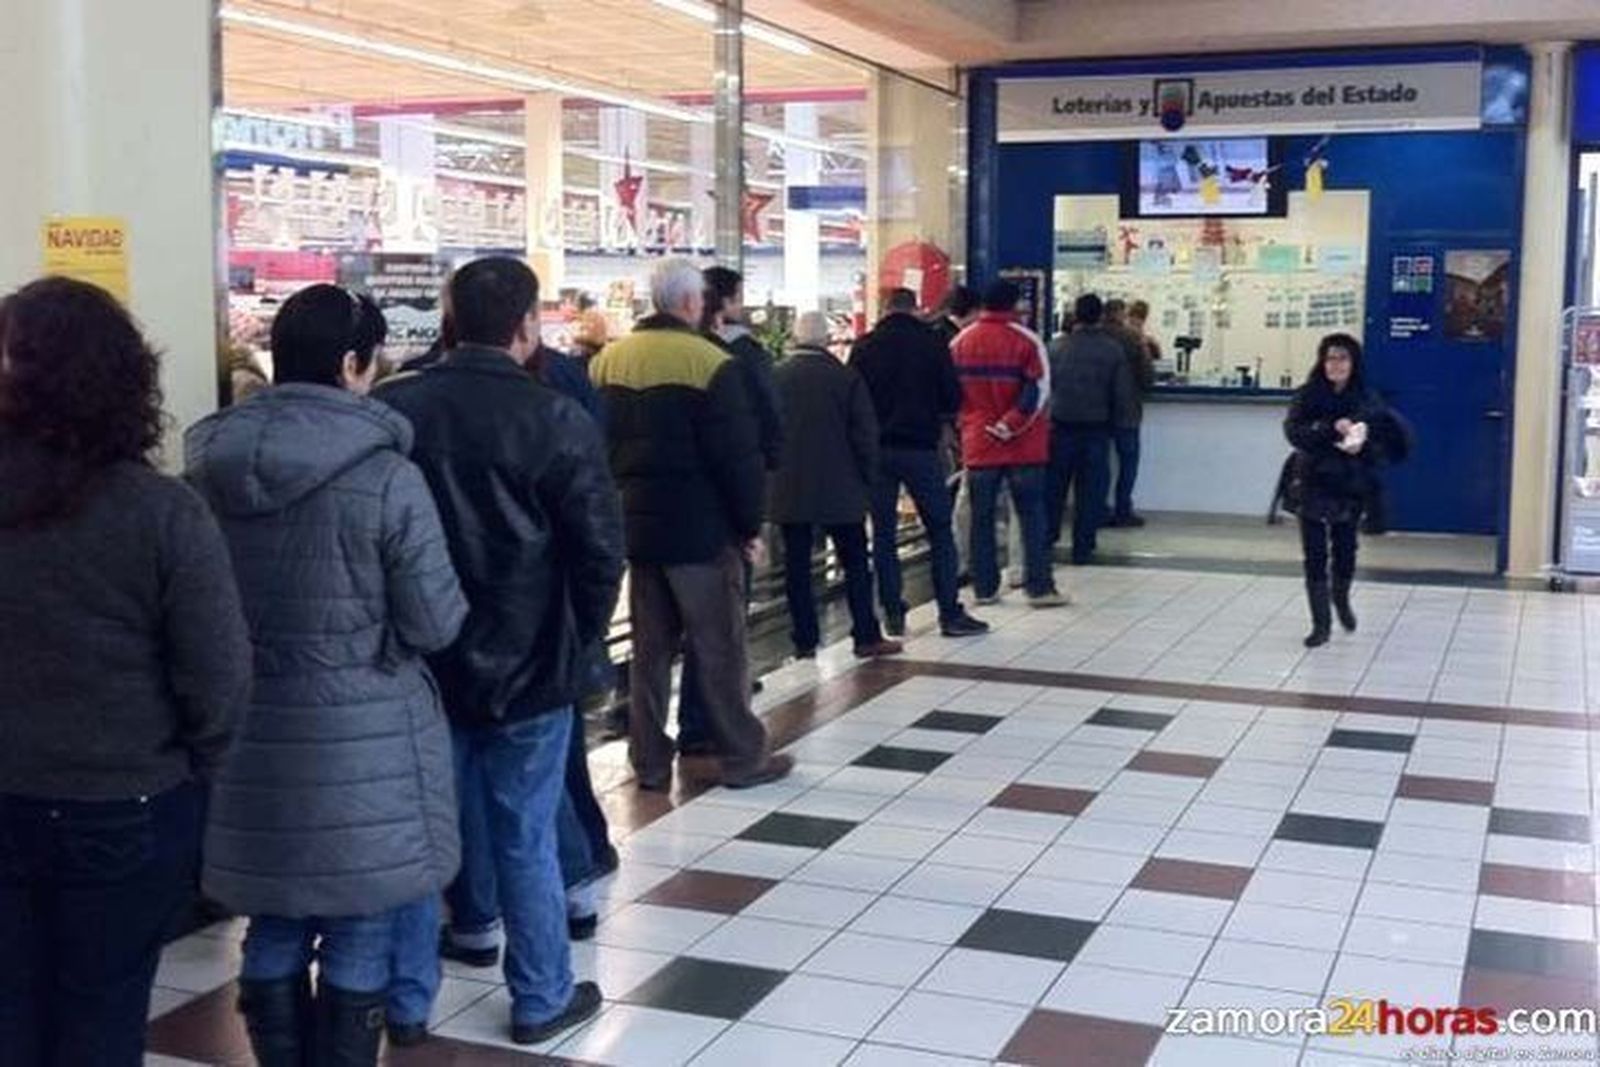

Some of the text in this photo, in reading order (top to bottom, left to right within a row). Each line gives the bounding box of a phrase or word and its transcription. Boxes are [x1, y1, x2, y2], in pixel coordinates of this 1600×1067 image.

[1139, 98, 1151, 116] y
[1198, 88, 1295, 114] Apuestas
[1301, 85, 1336, 107] del
[1341, 82, 1418, 104] Estado
[47, 228, 123, 248] NAVIDAD
